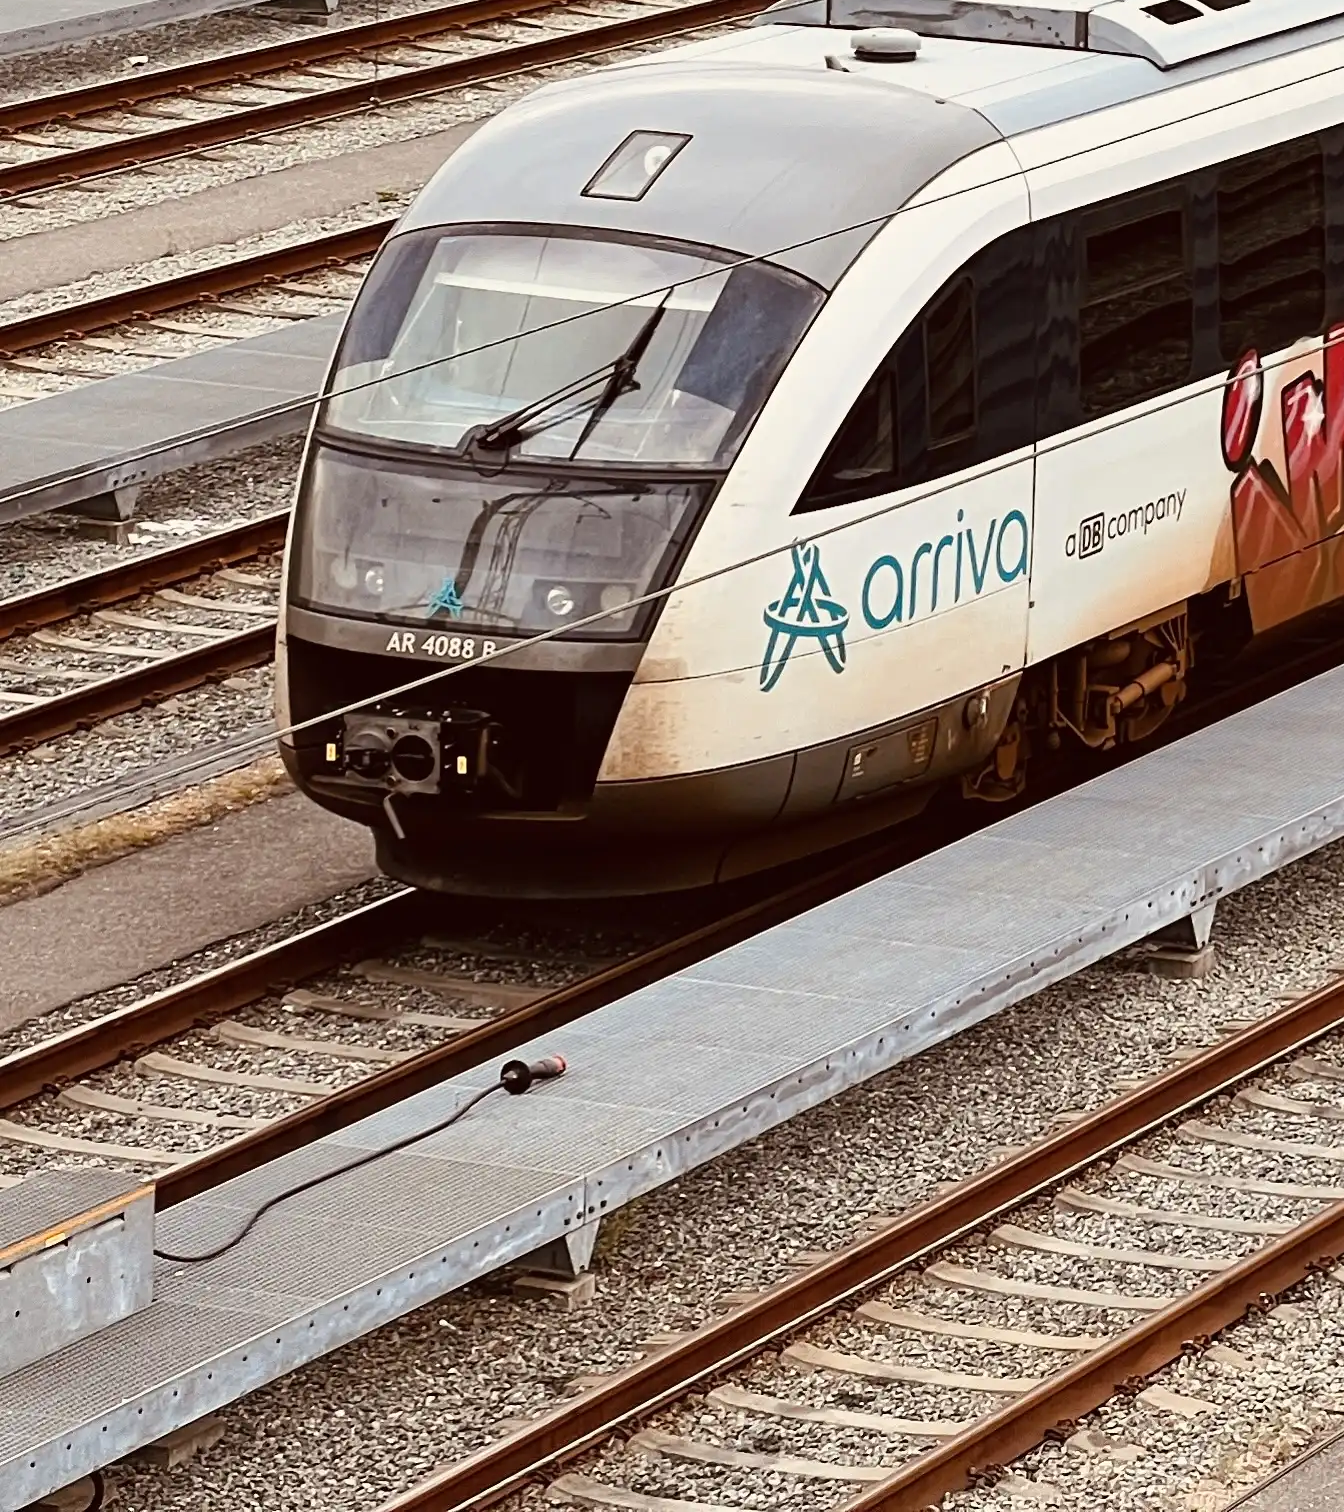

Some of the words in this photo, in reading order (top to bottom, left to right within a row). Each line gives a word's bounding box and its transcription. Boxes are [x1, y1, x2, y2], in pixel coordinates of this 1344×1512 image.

[1065, 533, 1076, 557] a
[1079, 515, 1103, 557] DB
[1106, 488, 1187, 540] company
[862, 508, 1029, 630] arriva
[386, 631, 416, 654] AR
[421, 635, 475, 660] 4088
[482, 640, 497, 658] B
